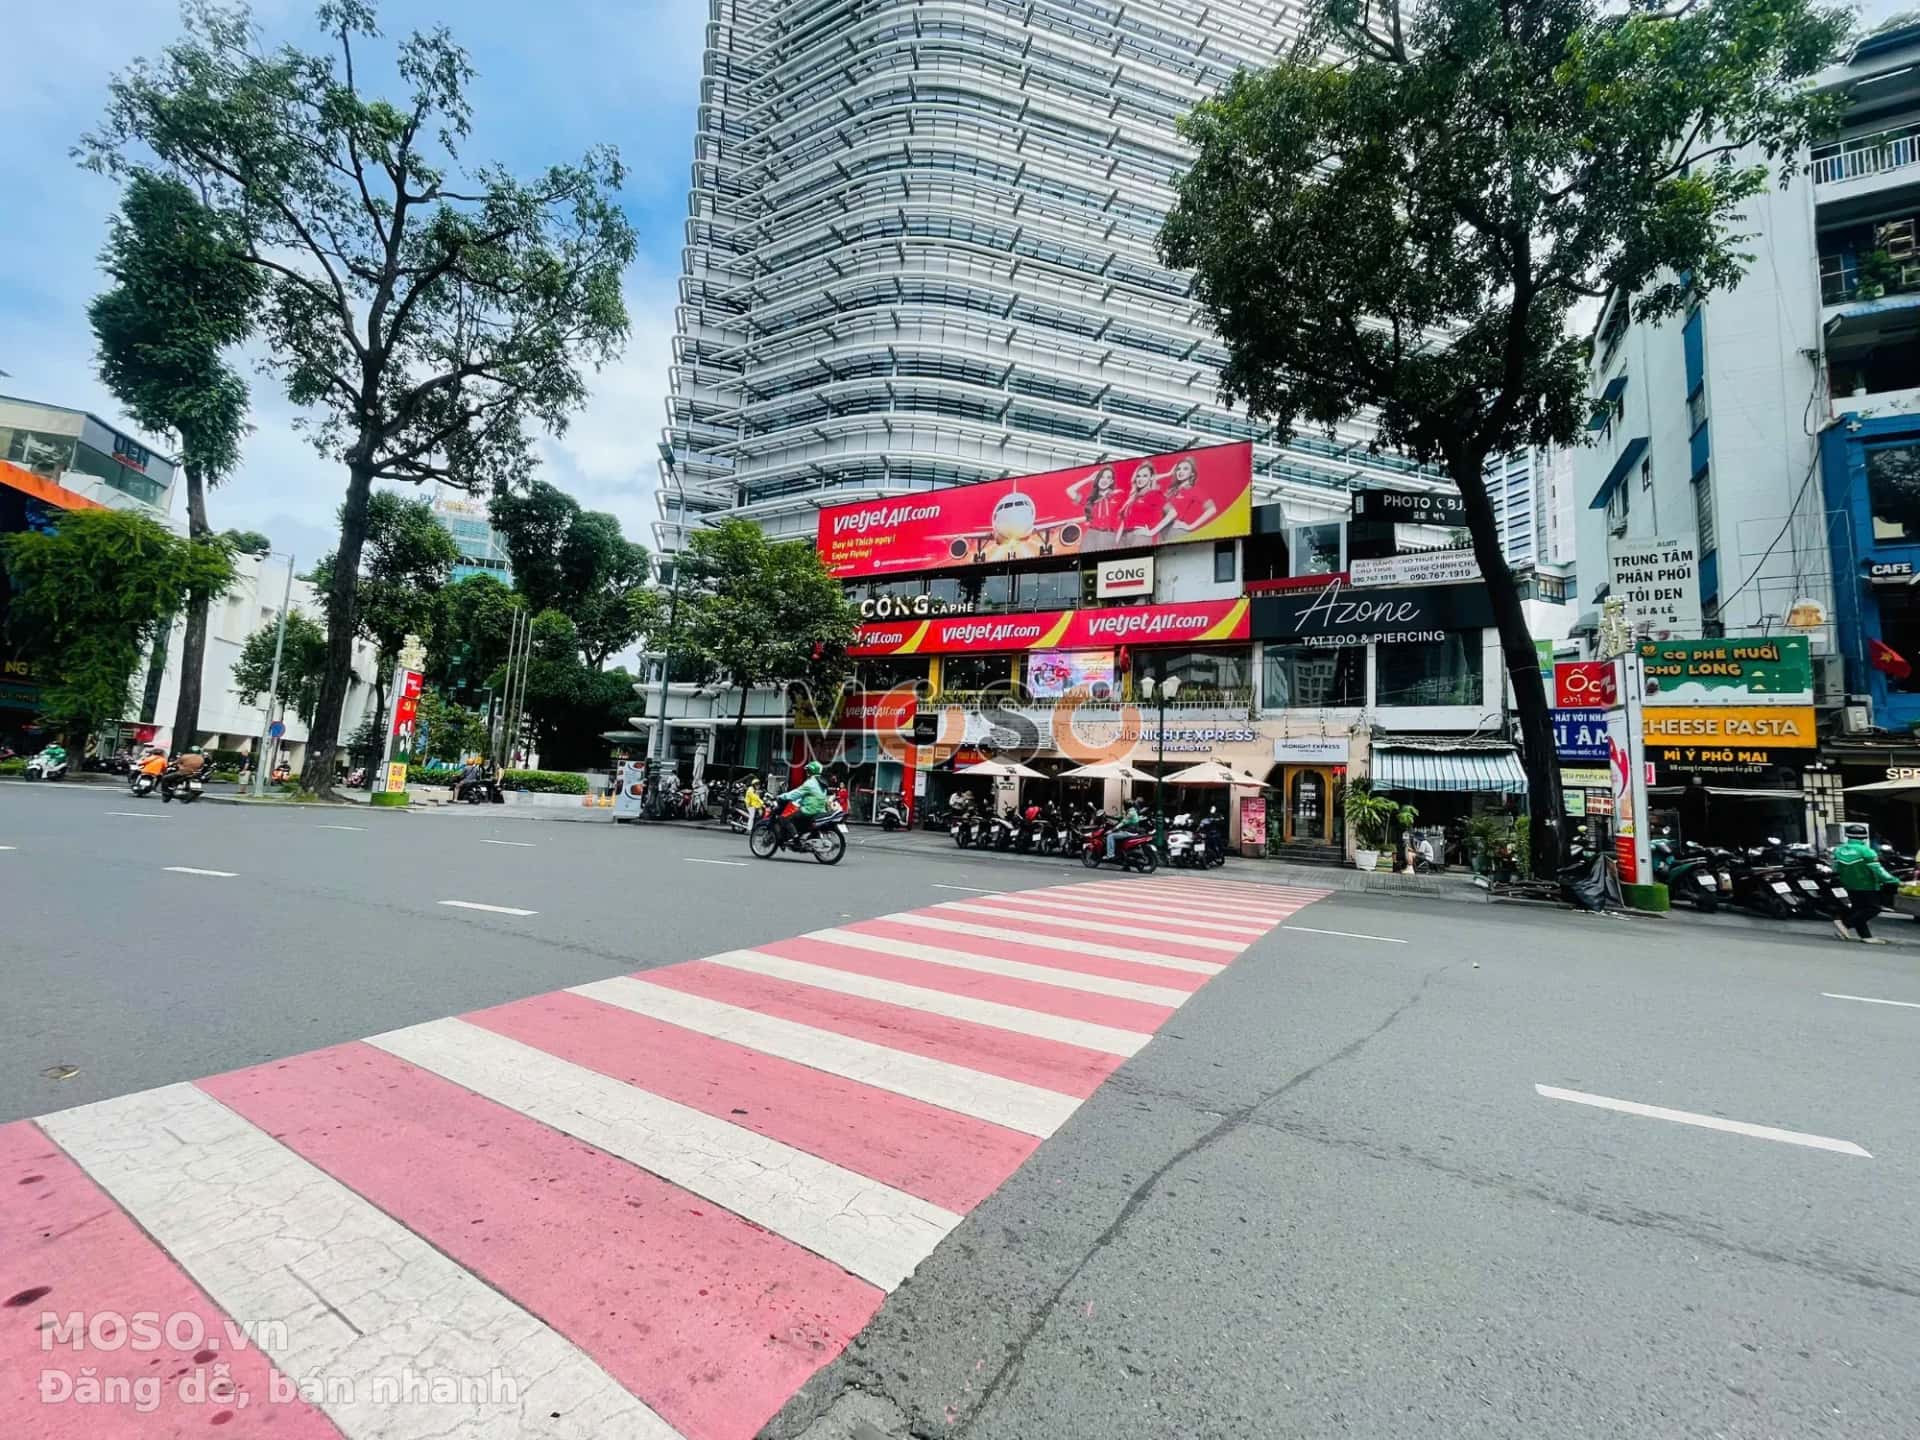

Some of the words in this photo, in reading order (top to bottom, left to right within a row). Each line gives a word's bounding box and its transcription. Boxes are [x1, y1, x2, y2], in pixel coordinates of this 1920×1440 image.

[1383, 494, 1431, 509] PHOTO
[1613, 553, 1658, 567] TRUNG
[1661, 549, 1693, 563] TÂM
[1410, 569, 1471, 581] 090.767.1919
[1616, 568, 1653, 584] PHÂN
[1657, 563, 1691, 580] PHỐI
[1871, 563, 1912, 575] CAFE
[1654, 587, 1683, 601] ĐEN
[1294, 577, 1421, 632] Azone
[1302, 634, 1357, 647] TATTOO
[1360, 633, 1370, 644] &
[1374, 630, 1446, 643] PIERCING
[1688, 663, 1742, 677] LONG
[1724, 718, 1801, 736] PASTA
[1184, 729, 1256, 743] EXPRESS
[1701, 748, 1734, 762] PHÔ
[1738, 751, 1768, 763] MAI
